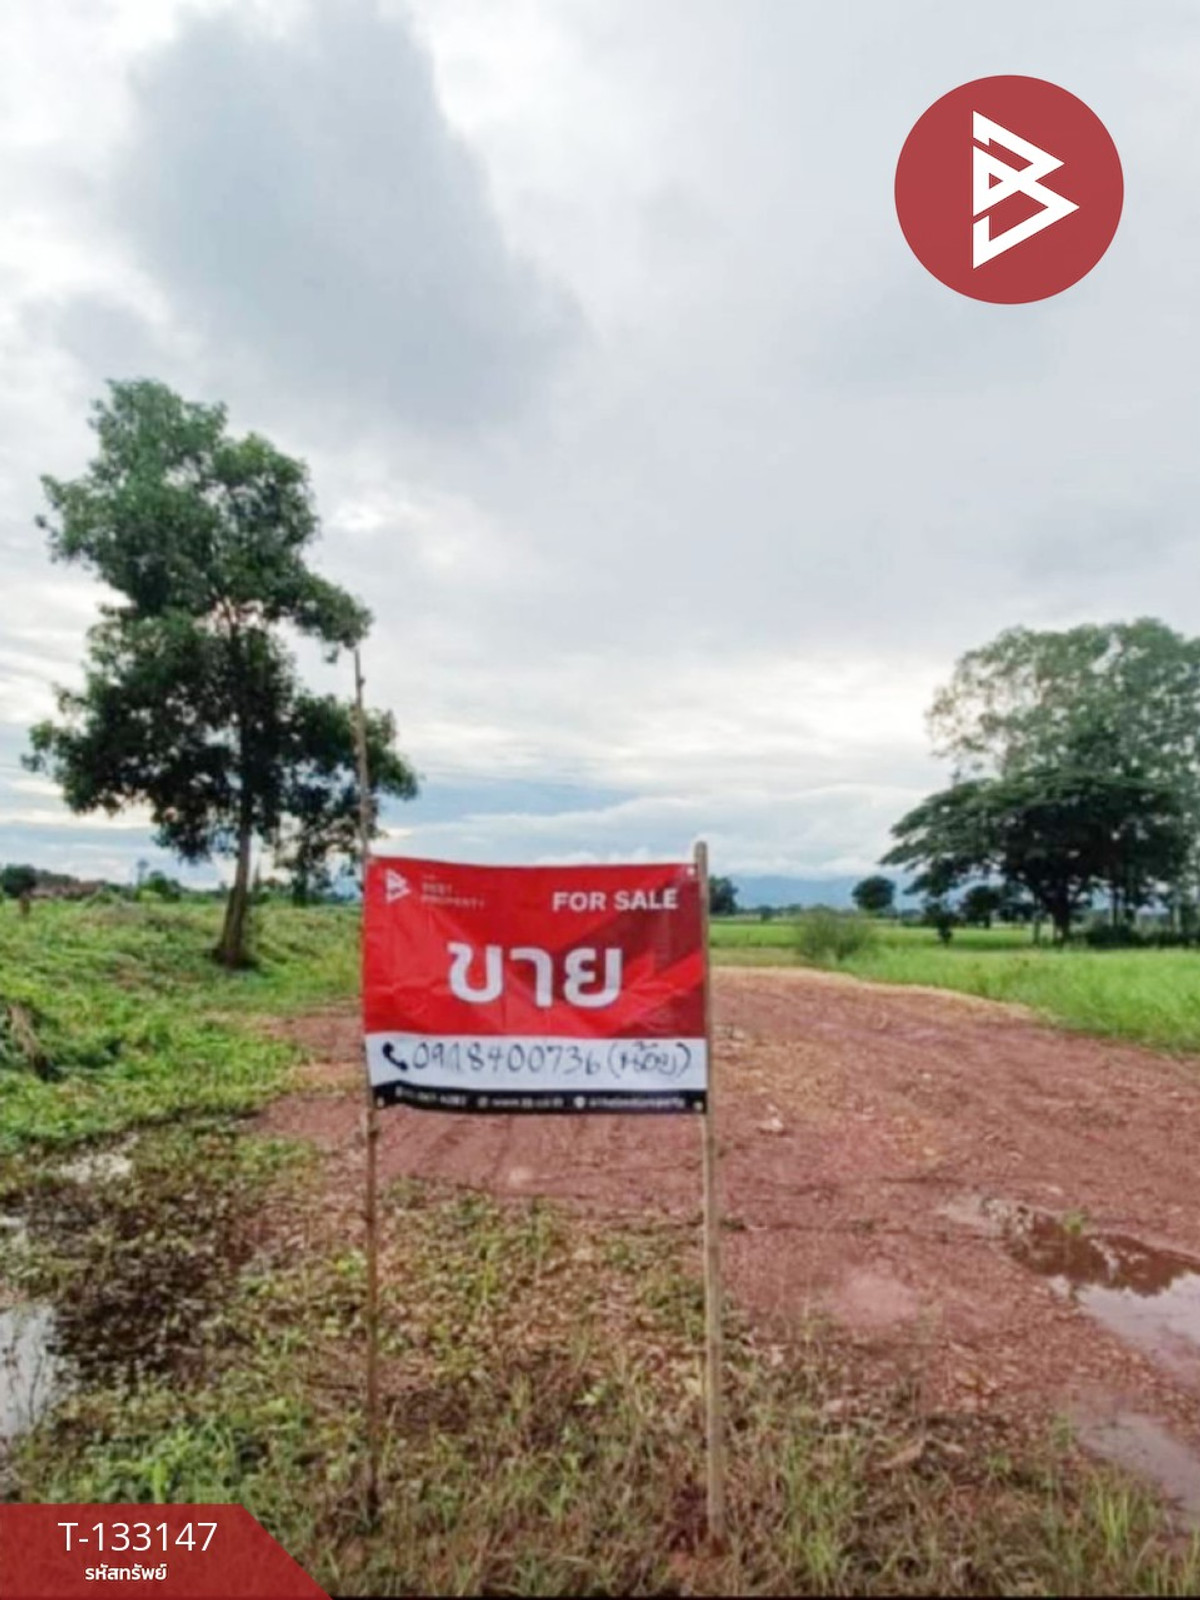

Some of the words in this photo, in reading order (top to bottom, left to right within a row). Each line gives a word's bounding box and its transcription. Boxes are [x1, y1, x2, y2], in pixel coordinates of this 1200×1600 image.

[552, 891, 605, 912] FOR
[614, 888, 678, 911] SALE
[446, 942, 623, 1008] ขาย
